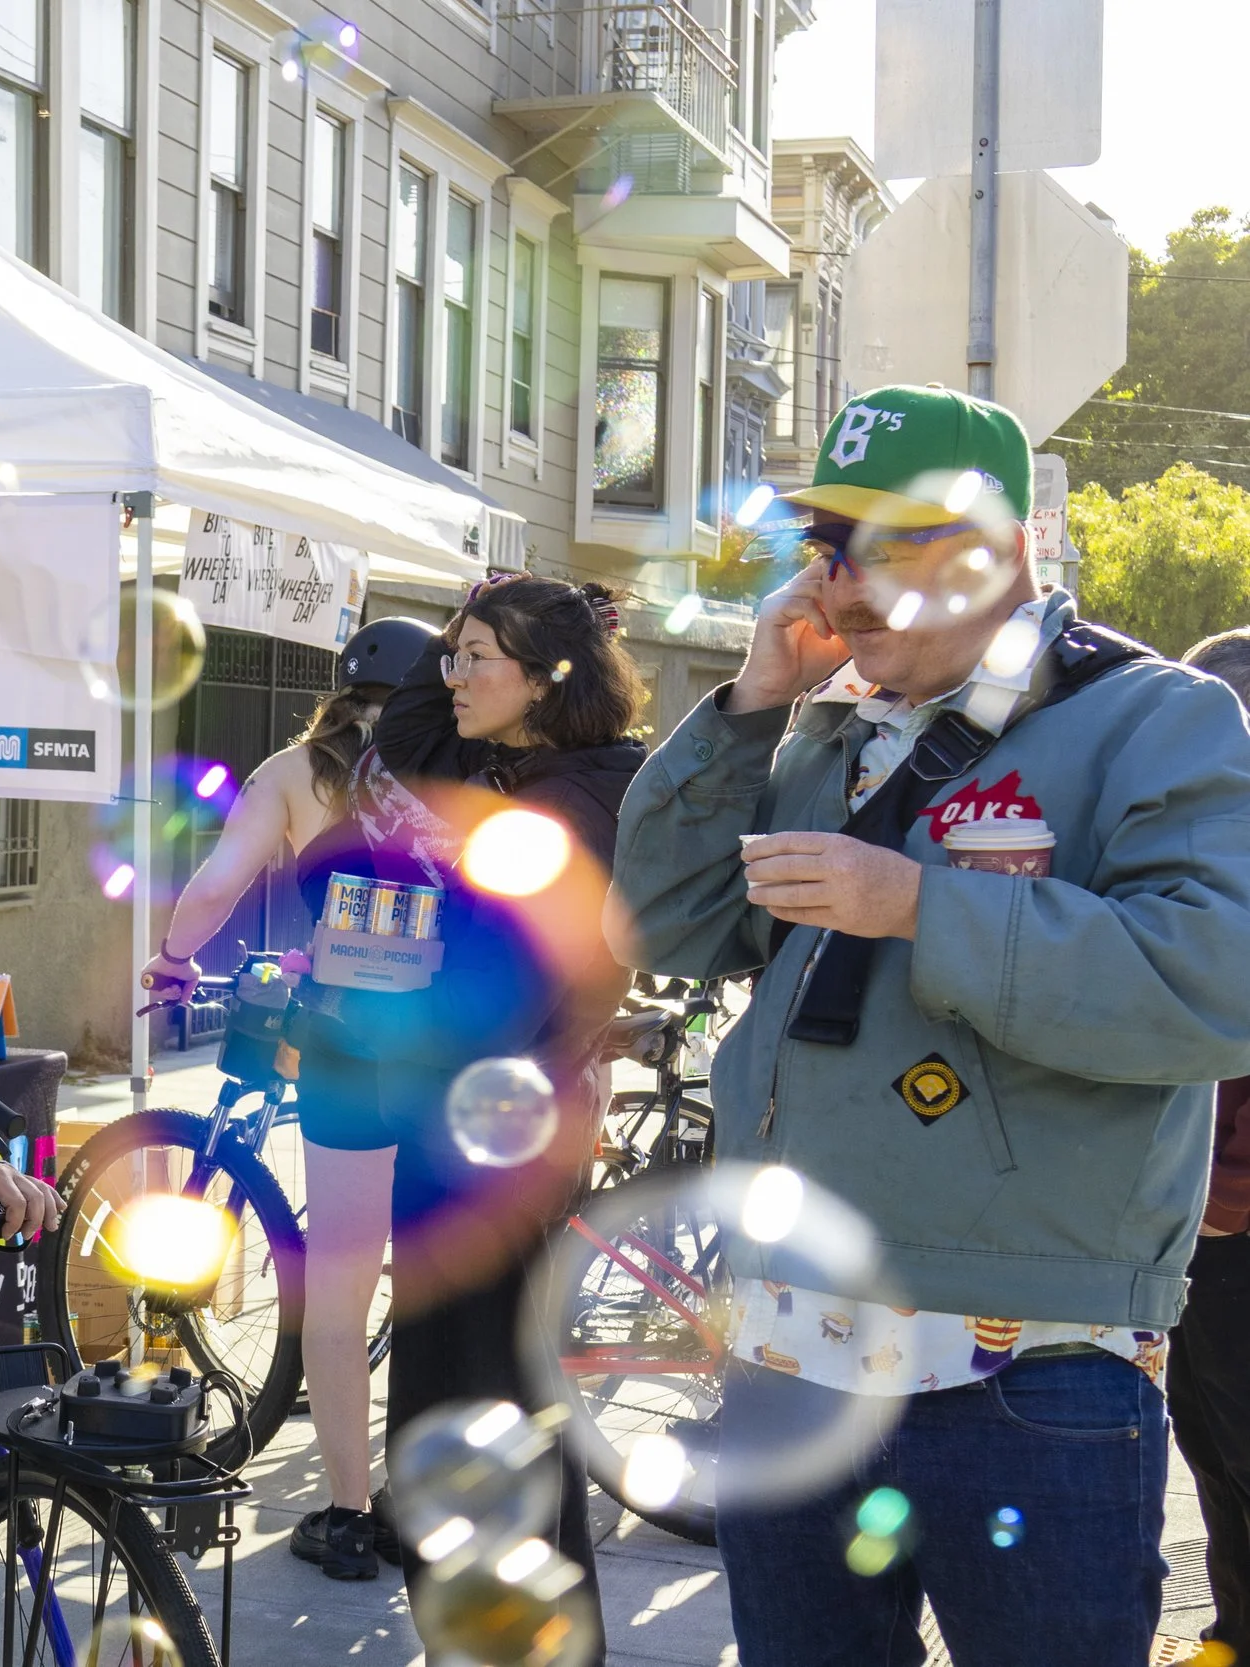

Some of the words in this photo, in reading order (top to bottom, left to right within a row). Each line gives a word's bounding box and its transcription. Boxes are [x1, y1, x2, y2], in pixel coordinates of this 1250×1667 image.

[828, 403, 906, 470] B's
[279, 578, 334, 604] WHEREVER
[292, 602, 319, 624] DAY
[33, 742, 90, 758] SFMTA
[940, 801, 1024, 824] OAKS
[330, 943, 369, 959] MACHU
[383, 949, 422, 965] PICCHU
